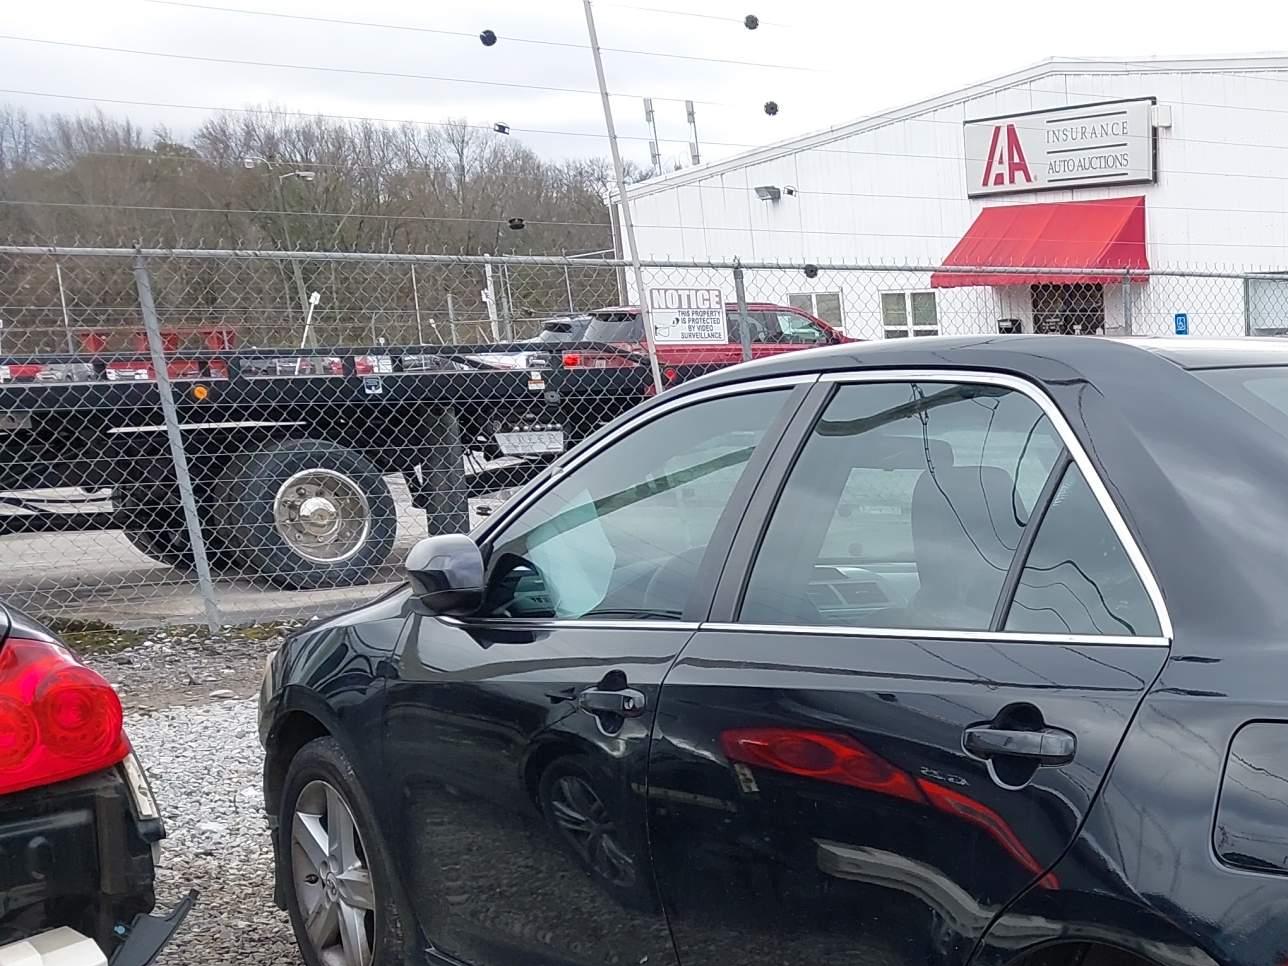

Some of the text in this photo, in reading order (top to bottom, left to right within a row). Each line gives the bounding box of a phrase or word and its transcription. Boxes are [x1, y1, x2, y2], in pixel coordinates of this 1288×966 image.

[1046, 121, 1129, 144] INSURANCE
[1047, 153, 1129, 175] AUTO AUCTIONS
[652, 289, 721, 309] NOTICE
[688, 317, 721, 325] PROTECTED
